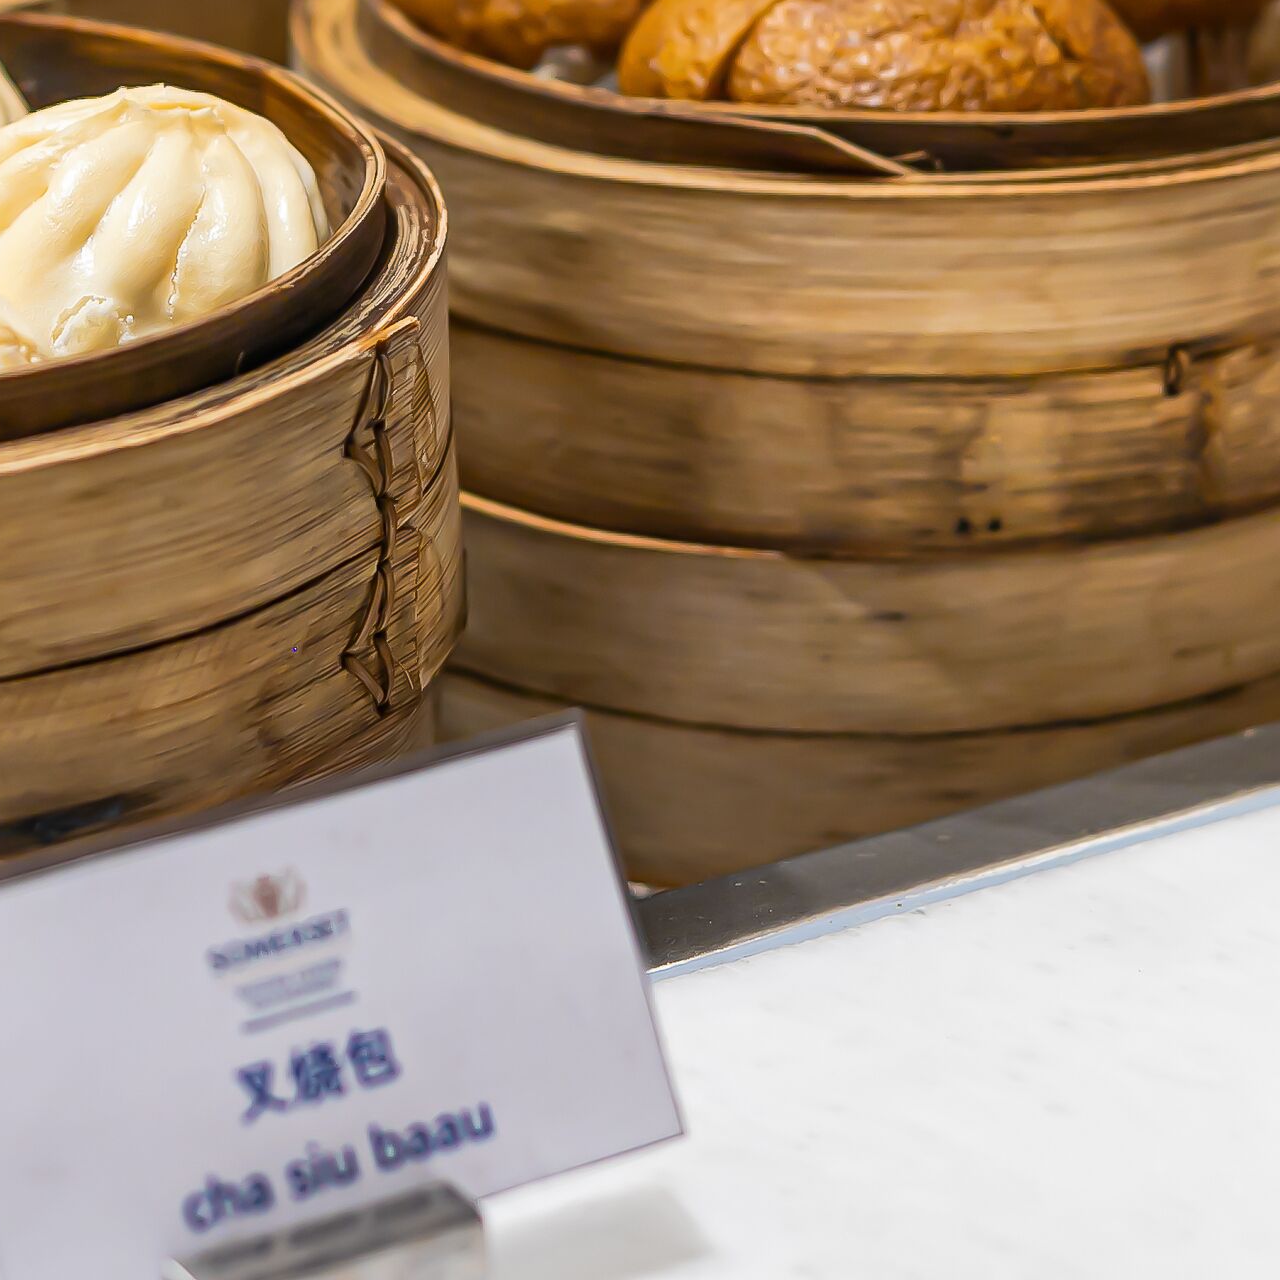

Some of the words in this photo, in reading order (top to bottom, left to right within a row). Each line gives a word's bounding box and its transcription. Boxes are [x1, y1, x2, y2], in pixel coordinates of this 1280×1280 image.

[235, 1026, 403, 1124] 叉烧包
[181, 1166, 275, 1234] cha
[285, 1140, 360, 1203] siu
[369, 1098, 496, 1175] baau
